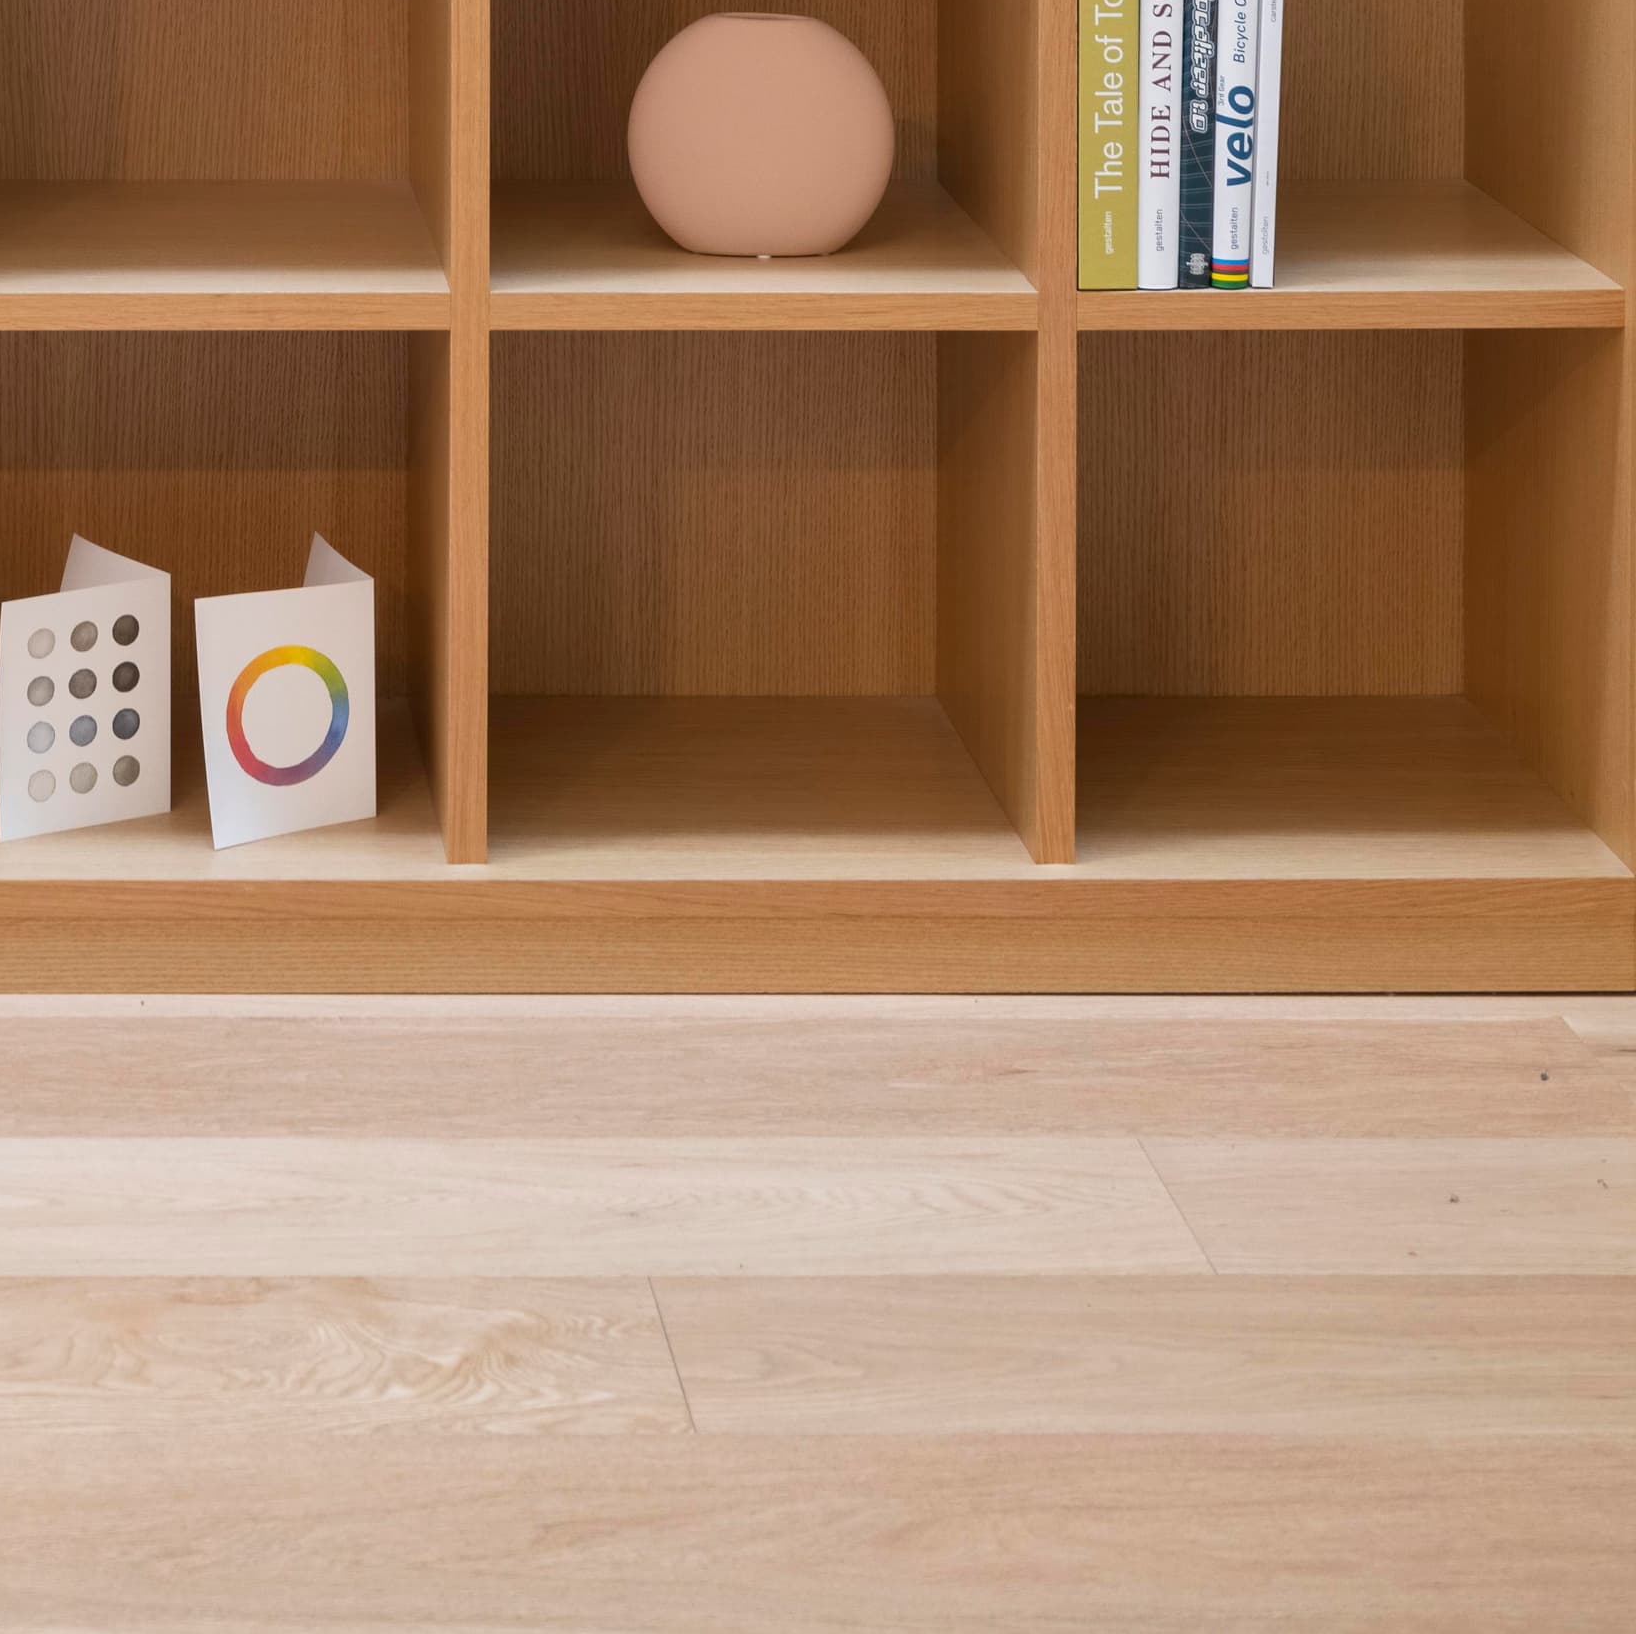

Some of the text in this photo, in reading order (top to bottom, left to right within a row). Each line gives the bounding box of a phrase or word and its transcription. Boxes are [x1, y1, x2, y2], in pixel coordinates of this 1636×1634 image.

[1094, 35, 1124, 63] of
[1152, 31, 1172, 93] AND
[1233, 12, 1247, 63] Bicycle
[1095, 73, 1123, 134] Tale
[1150, 105, 1171, 179] HIDE
[1216, 86, 1254, 186] velo
[1095, 141, 1123, 199] The
[1230, 207, 1239, 250] gestalten
